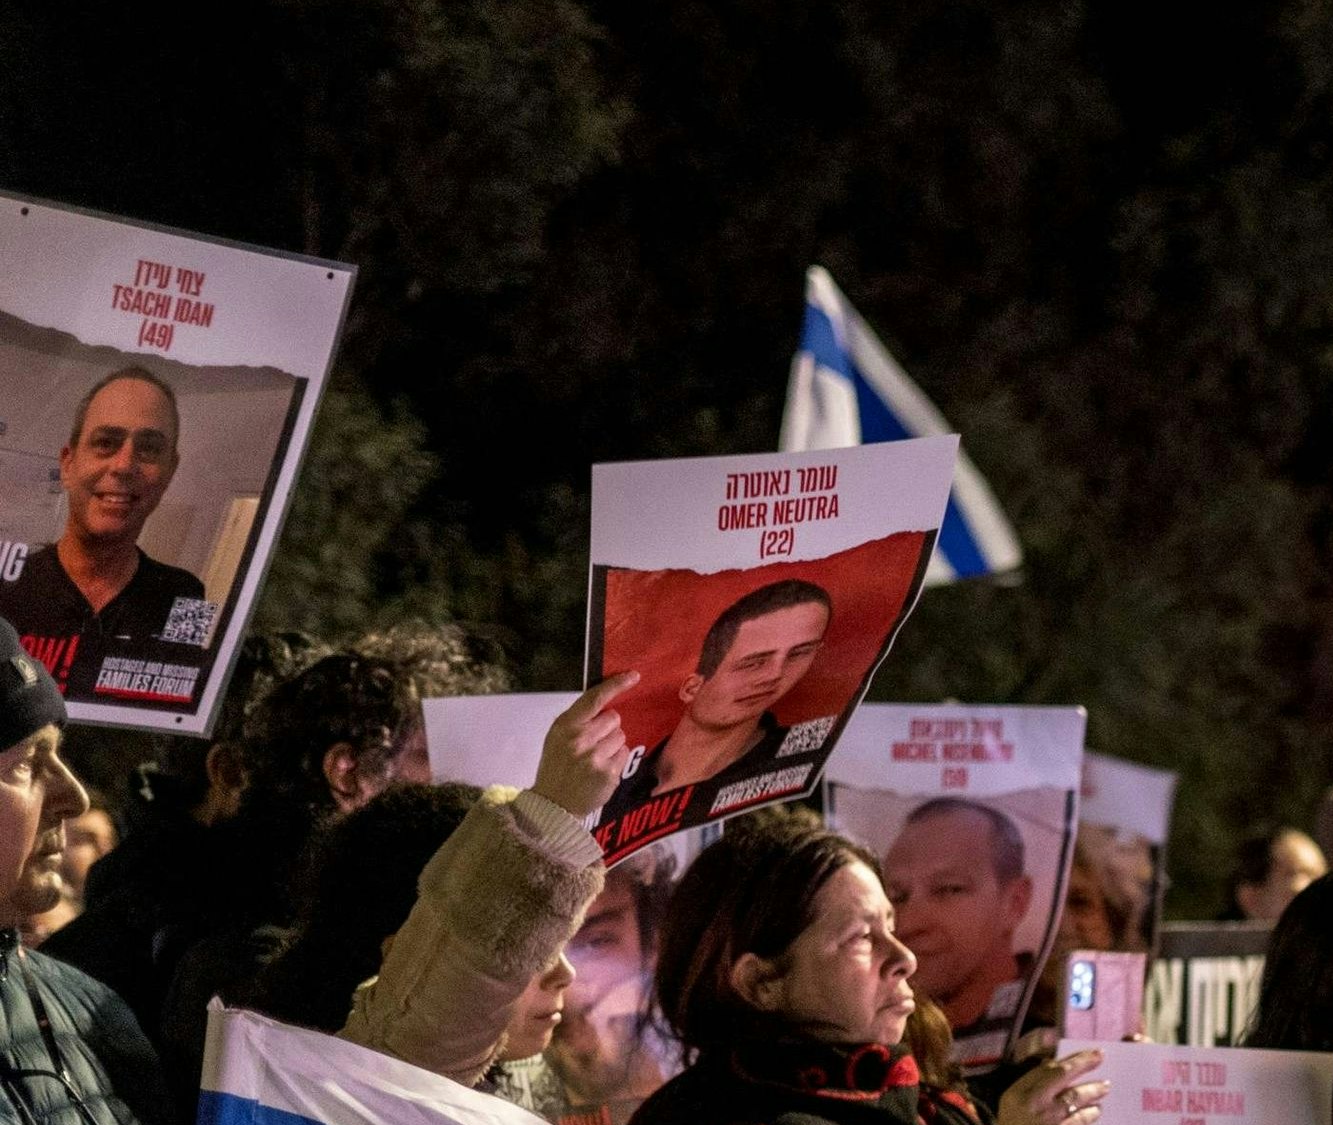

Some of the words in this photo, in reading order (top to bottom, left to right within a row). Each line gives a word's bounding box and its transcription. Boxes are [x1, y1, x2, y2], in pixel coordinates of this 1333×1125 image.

[135, 260, 171, 290] עידן
[176, 268, 205, 297] צחי
[112, 284, 172, 319] TSACHI
[174, 298, 215, 328] IDAN
[138, 319, 174, 352] (49)
[726, 470, 791, 500] נאוטרה
[797, 465, 837, 494] עומר
[718, 502, 768, 531] OMER
[773, 494, 839, 526] NEUTRA
[760, 527, 794, 559] (22)
[97, 669, 151, 691] FAMILIES
[150, 677, 196, 697] FORUM
